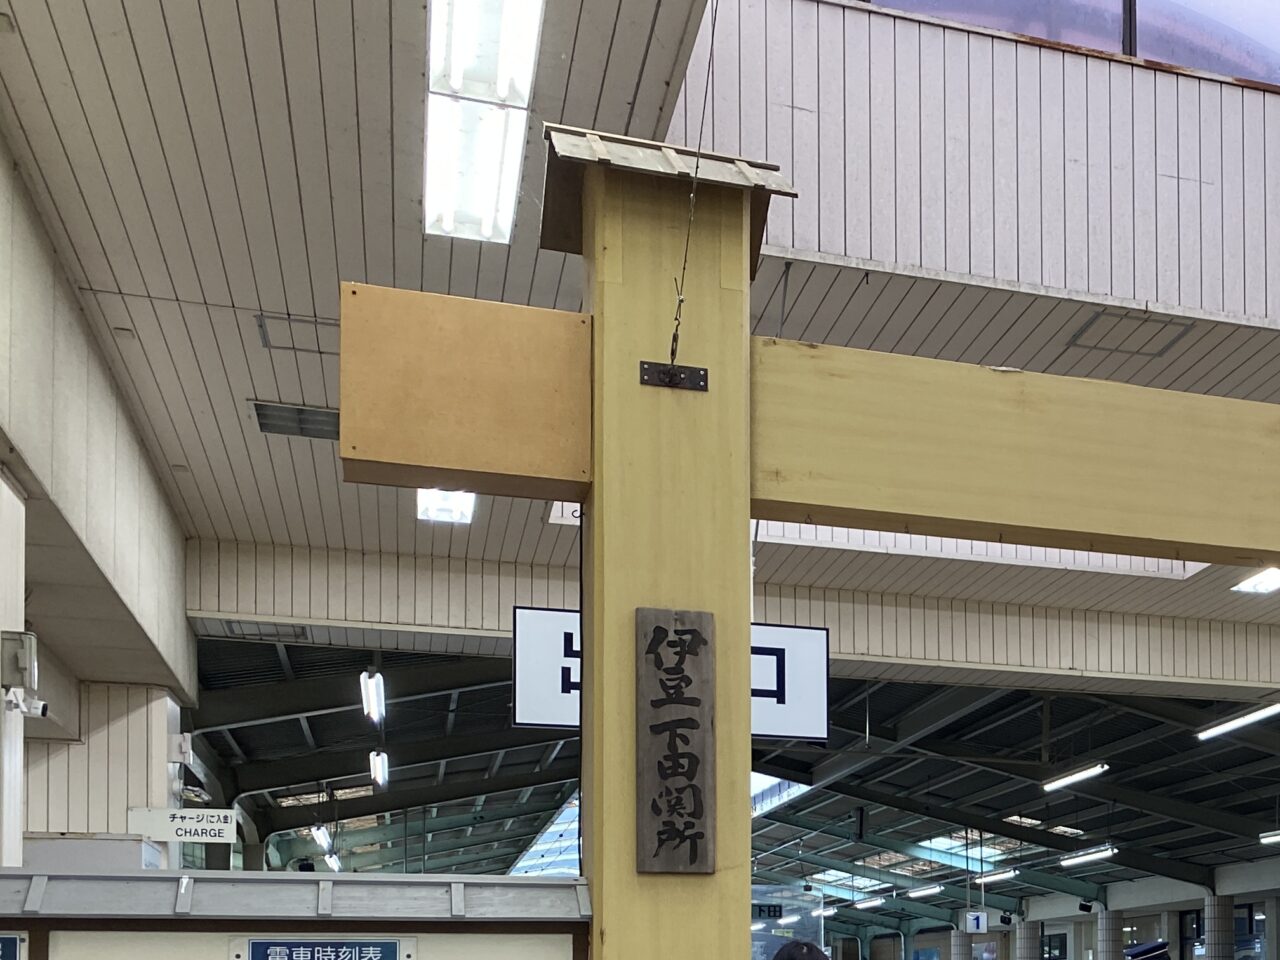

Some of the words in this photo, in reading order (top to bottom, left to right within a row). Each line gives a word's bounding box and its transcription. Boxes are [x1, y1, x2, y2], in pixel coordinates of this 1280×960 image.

[645, 625, 708, 866] 伊豆下田関所
[175, 827, 225, 838] CHARGE
[972, 915, 980, 930] 1
